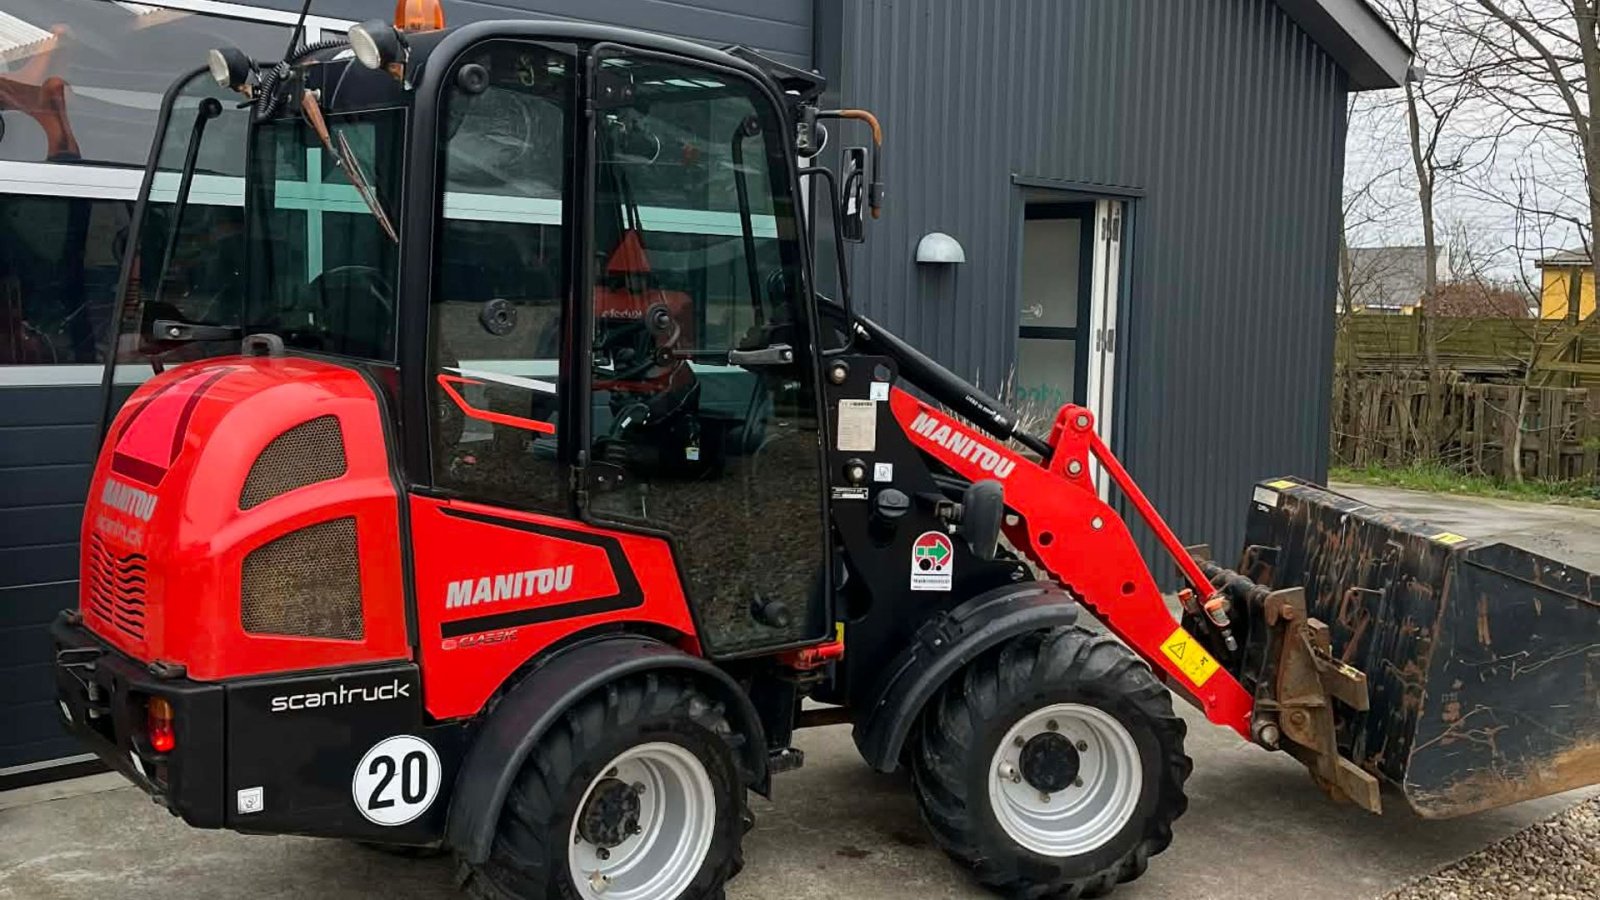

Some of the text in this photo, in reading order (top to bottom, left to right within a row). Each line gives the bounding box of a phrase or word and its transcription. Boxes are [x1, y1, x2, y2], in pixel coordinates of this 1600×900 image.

[910, 413, 1016, 479] MANITOU
[101, 478, 158, 522] MANITOU
[446, 565, 573, 609] MANITOU
[271, 680, 410, 713] scantruck
[367, 751, 428, 811] 20
